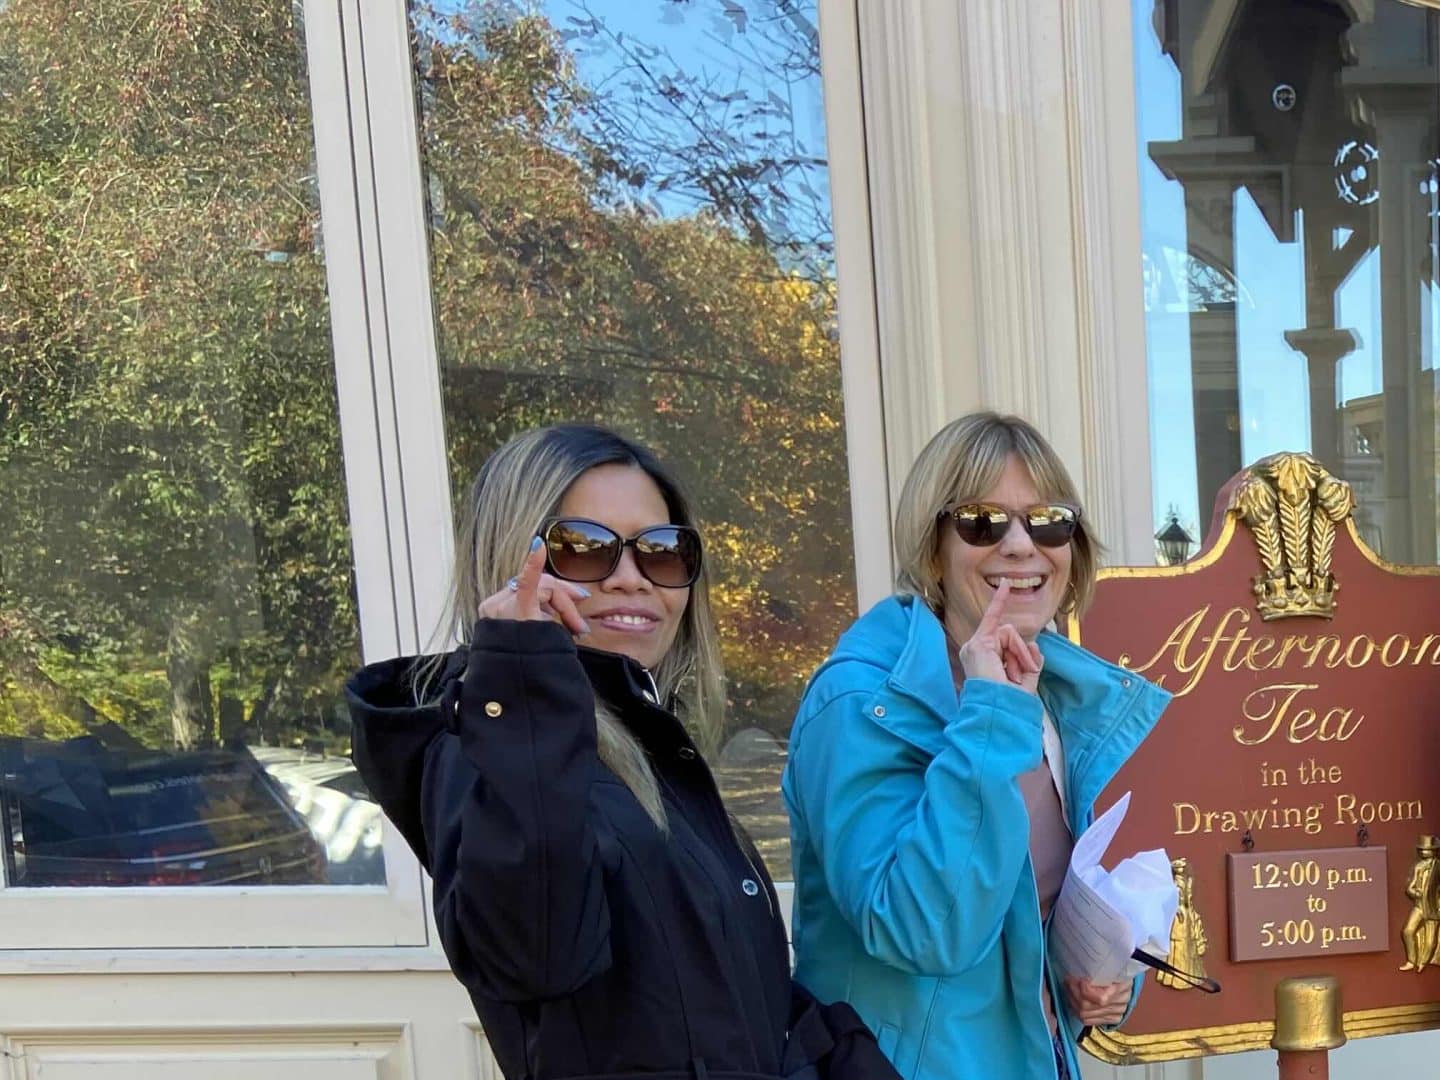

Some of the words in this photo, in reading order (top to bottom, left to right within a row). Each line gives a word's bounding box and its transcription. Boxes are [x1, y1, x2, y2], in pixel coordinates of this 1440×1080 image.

[1233, 682, 1364, 745] Tea
[1261, 762, 1288, 787] in
[1298, 758, 1343, 785] the
[1173, 798, 1324, 835] Drawing
[1333, 794, 1424, 825] Room
[1252, 860, 1320, 889] 12:00
[1326, 865, 1373, 890] p.m.
[1306, 894, 1327, 913] to
[1260, 919, 1315, 947] 5:00
[1321, 924, 1367, 948] p.m.
